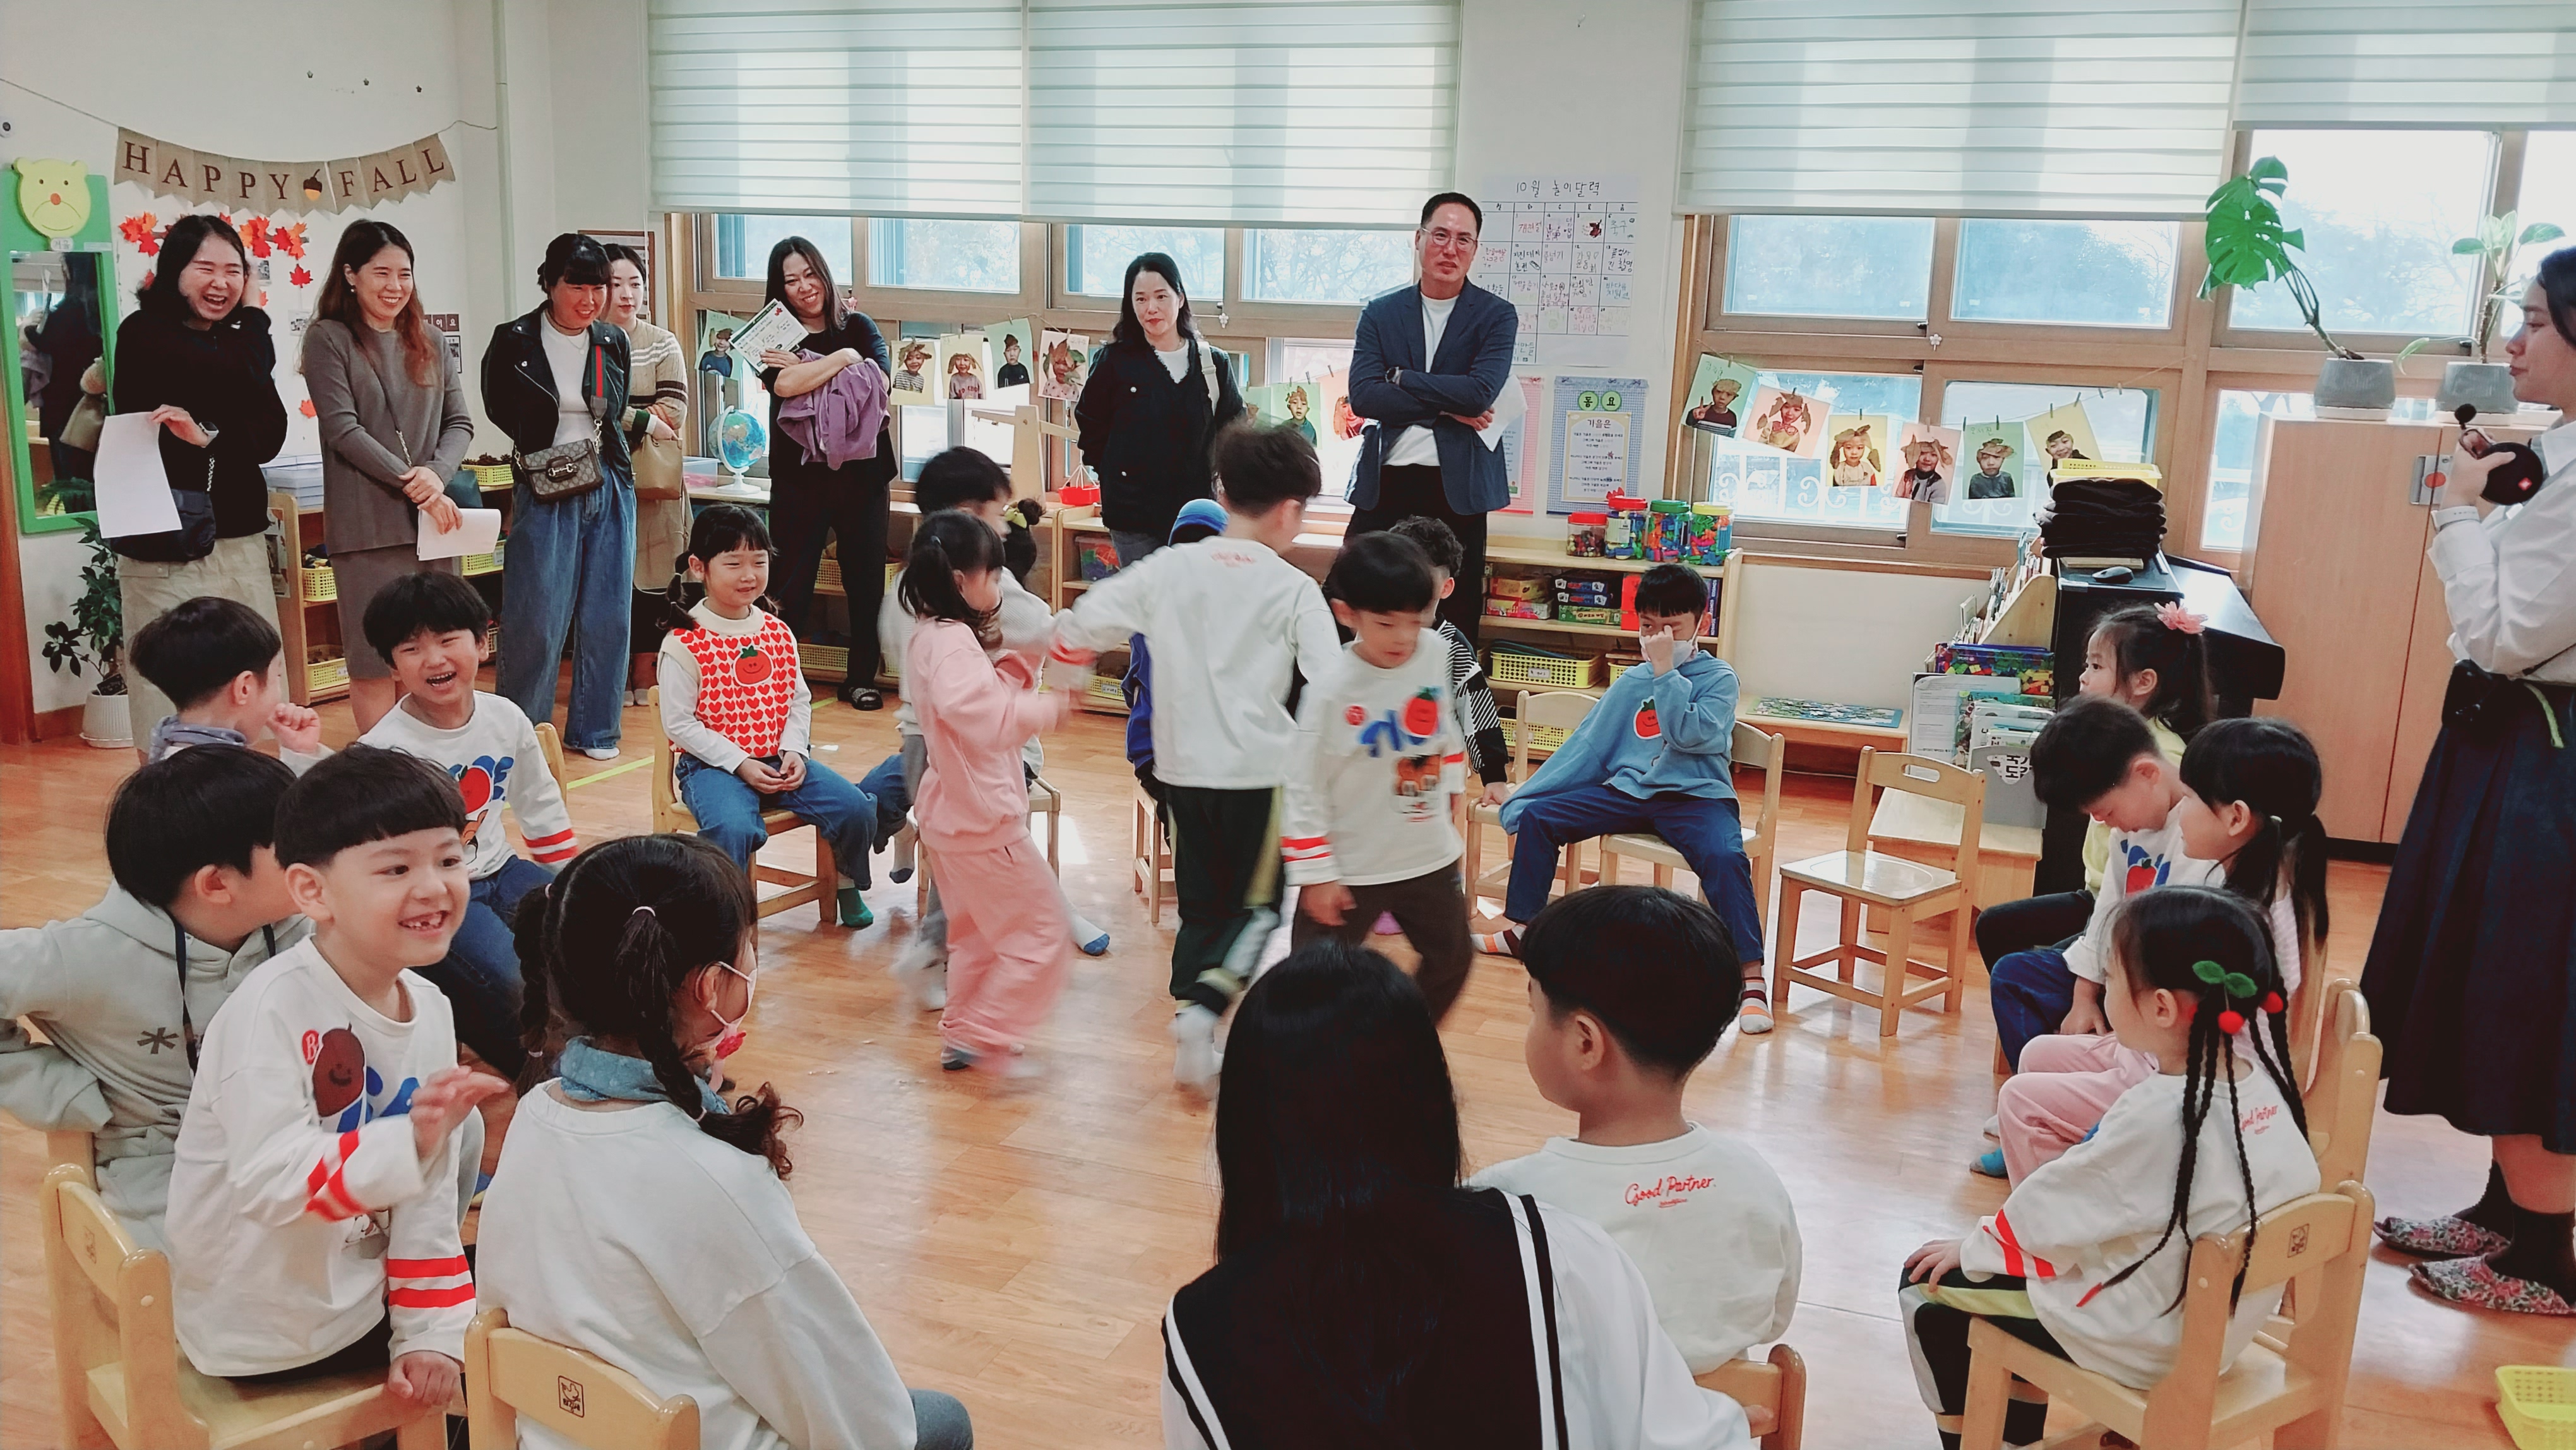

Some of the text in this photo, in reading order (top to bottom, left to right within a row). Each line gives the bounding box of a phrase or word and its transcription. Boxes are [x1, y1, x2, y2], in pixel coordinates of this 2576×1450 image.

[122, 141, 444, 200] HAPPY FALL
[1625, 1178, 1662, 1206] Good
